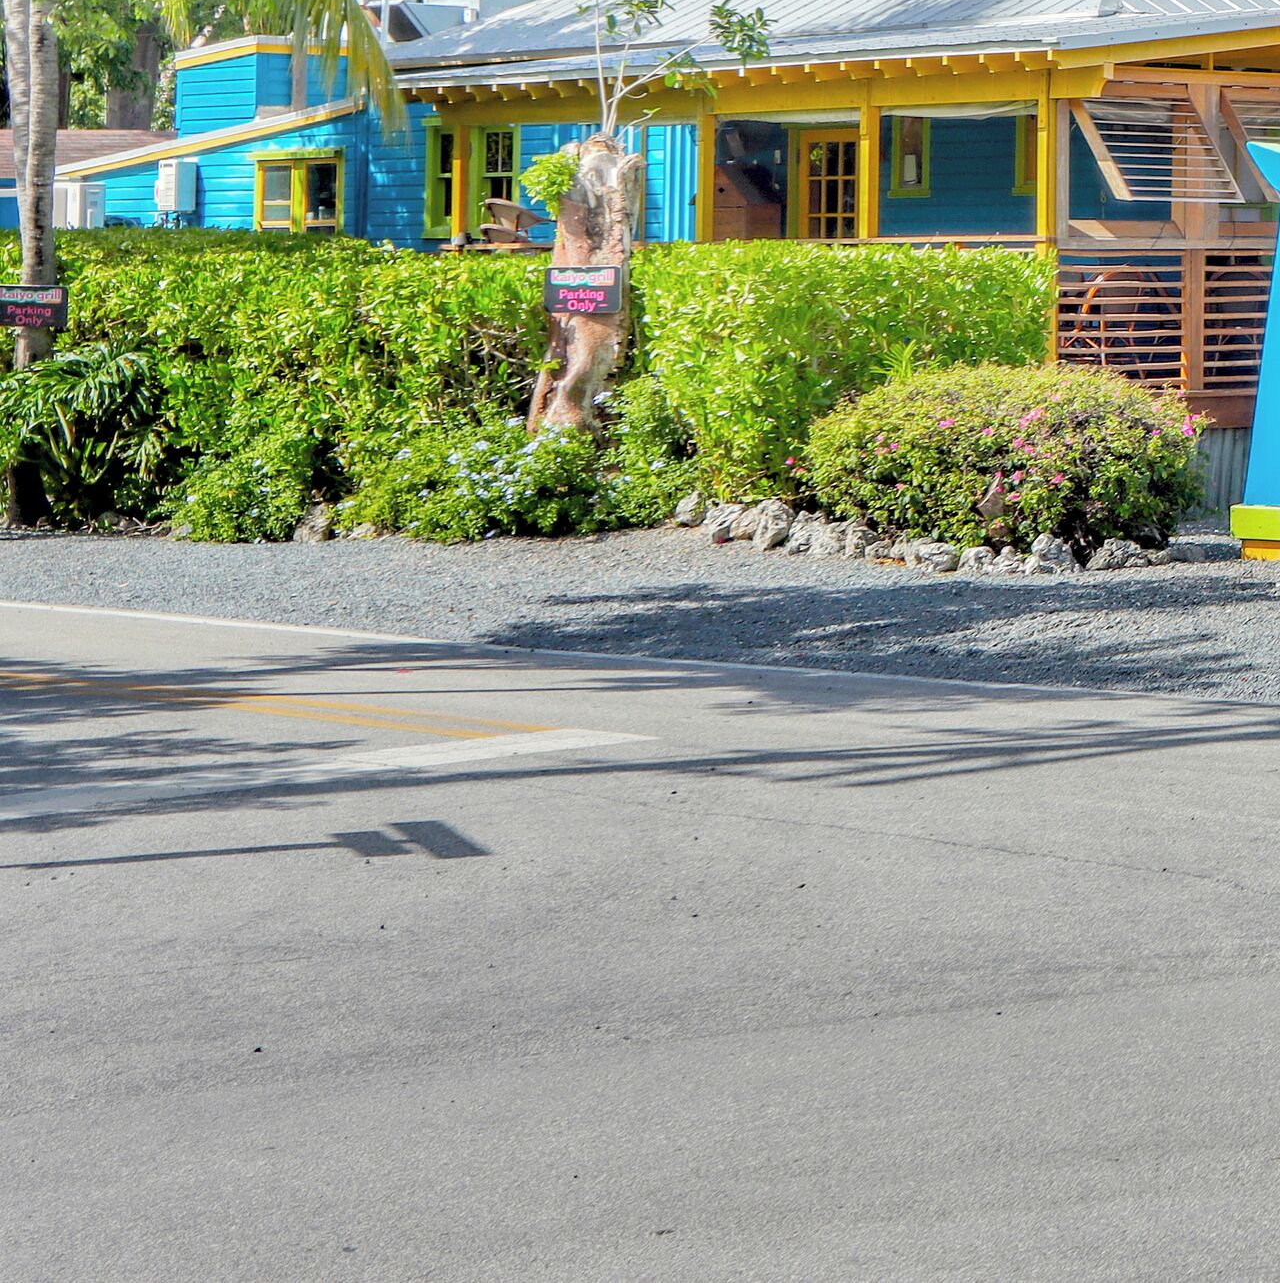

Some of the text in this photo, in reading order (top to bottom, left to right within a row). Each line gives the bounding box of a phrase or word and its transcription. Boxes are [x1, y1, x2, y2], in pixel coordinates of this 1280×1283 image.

[551, 269, 615, 284] kaiyo grill
[0, 288, 62, 301] kaiyo grill
[559, 289, 605, 301] Parking
[7, 305, 51, 317] Parking
[567, 300, 596, 312] Only
[15, 314, 44, 326] Only
